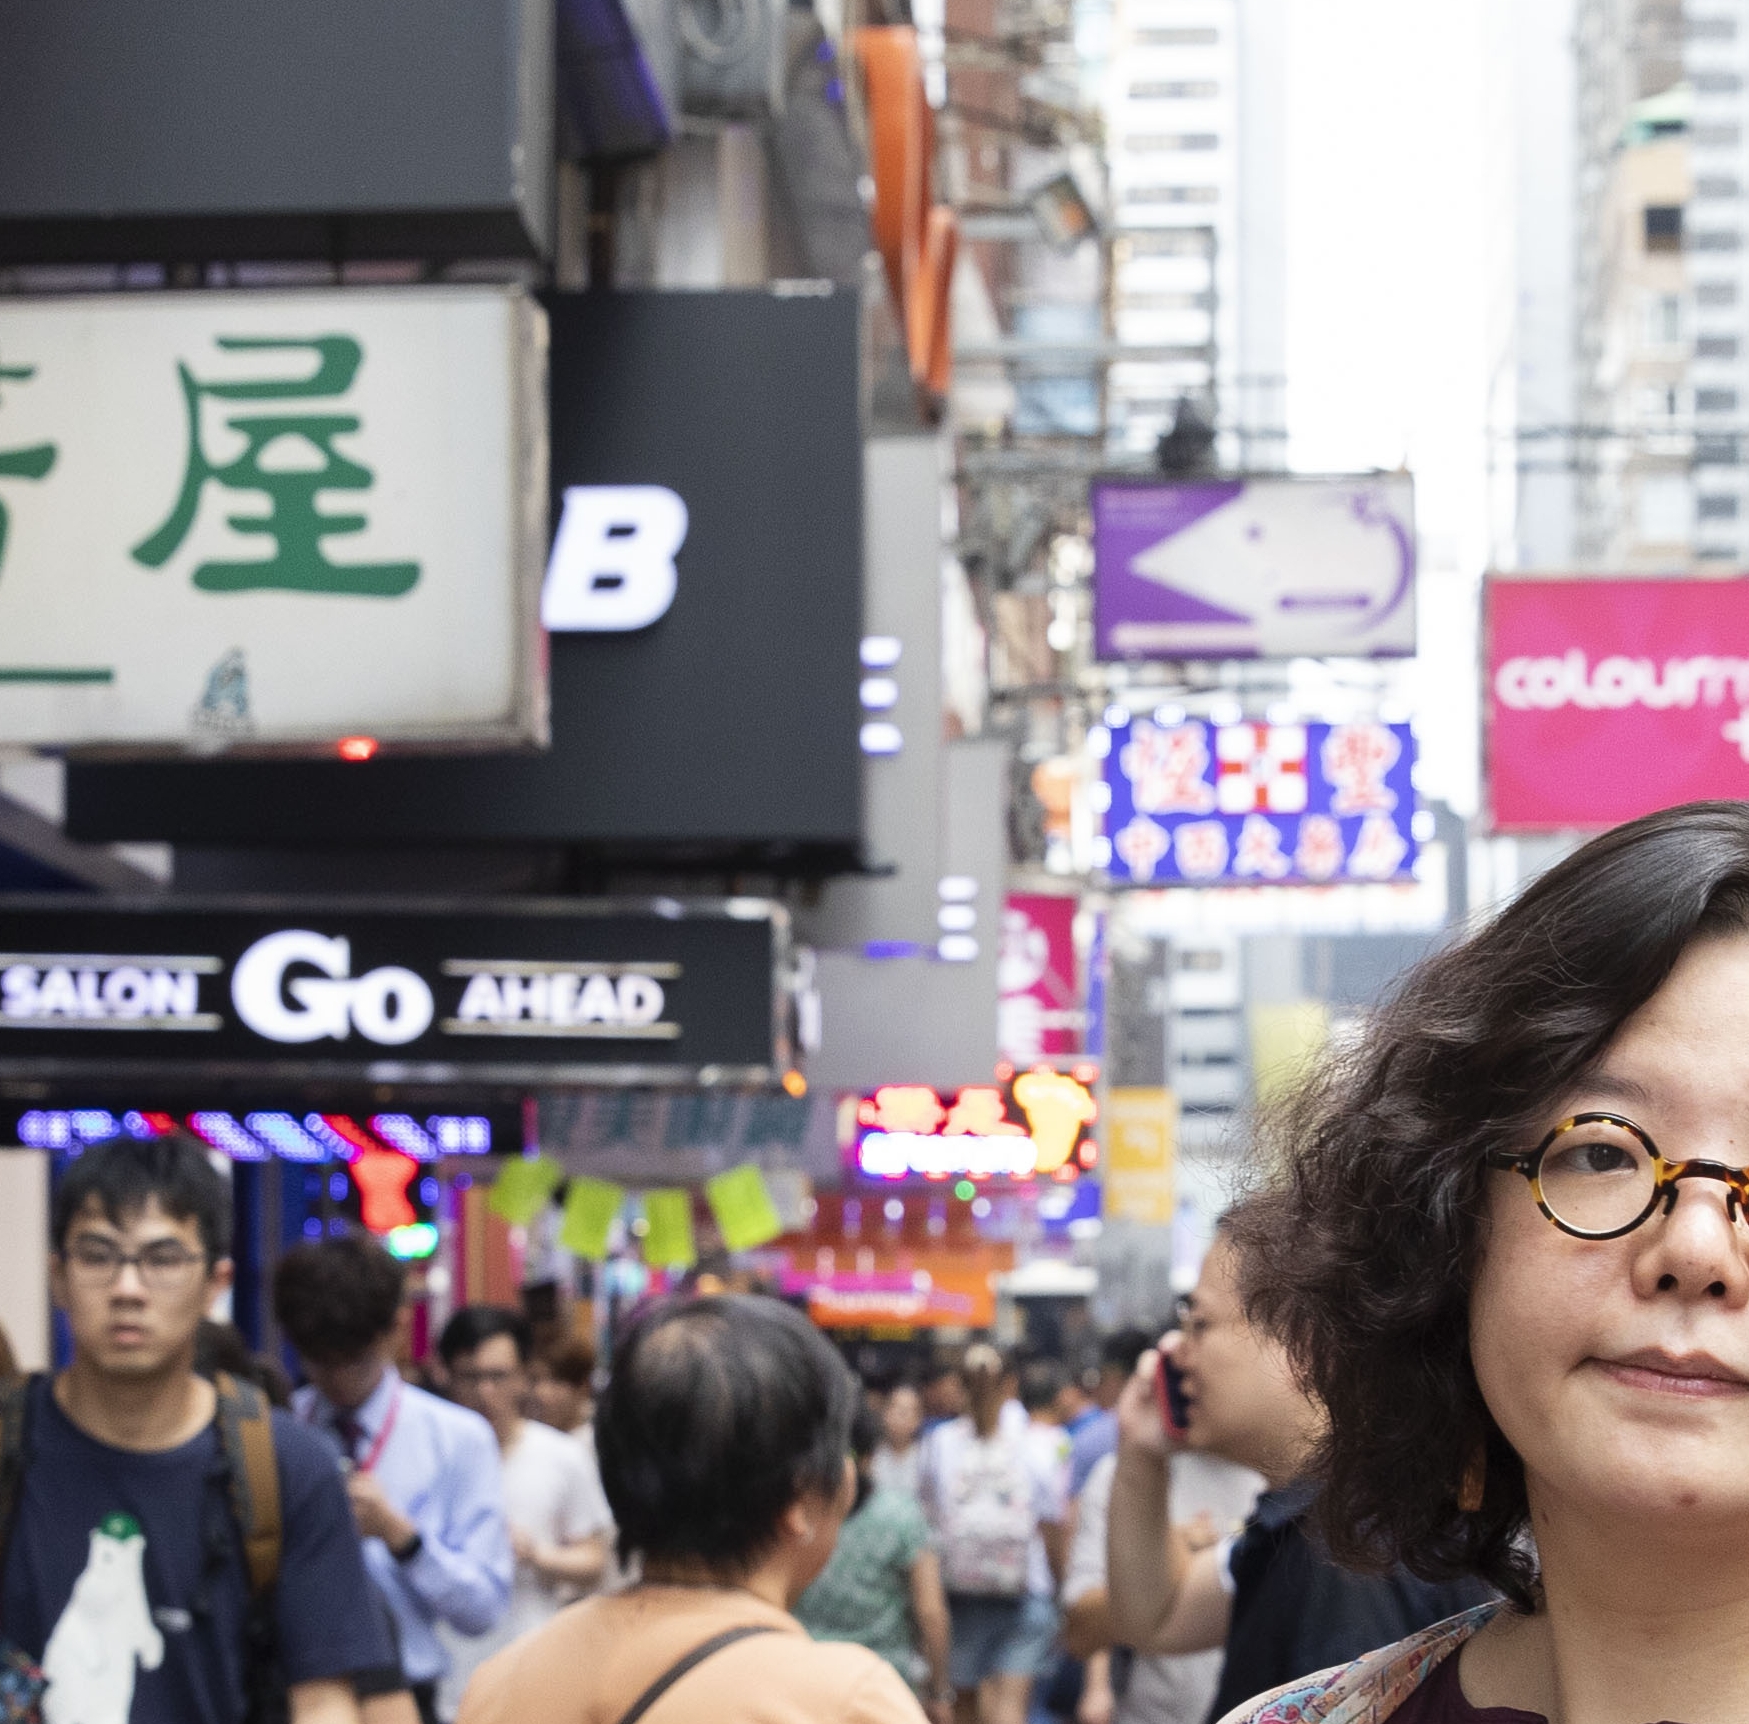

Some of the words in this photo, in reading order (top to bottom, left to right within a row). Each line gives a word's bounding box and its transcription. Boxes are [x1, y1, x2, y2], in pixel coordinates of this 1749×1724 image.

[0, 965, 199, 1020] SALON
[231, 929, 435, 1046] Go
[457, 970, 666, 1028] AHEAD
